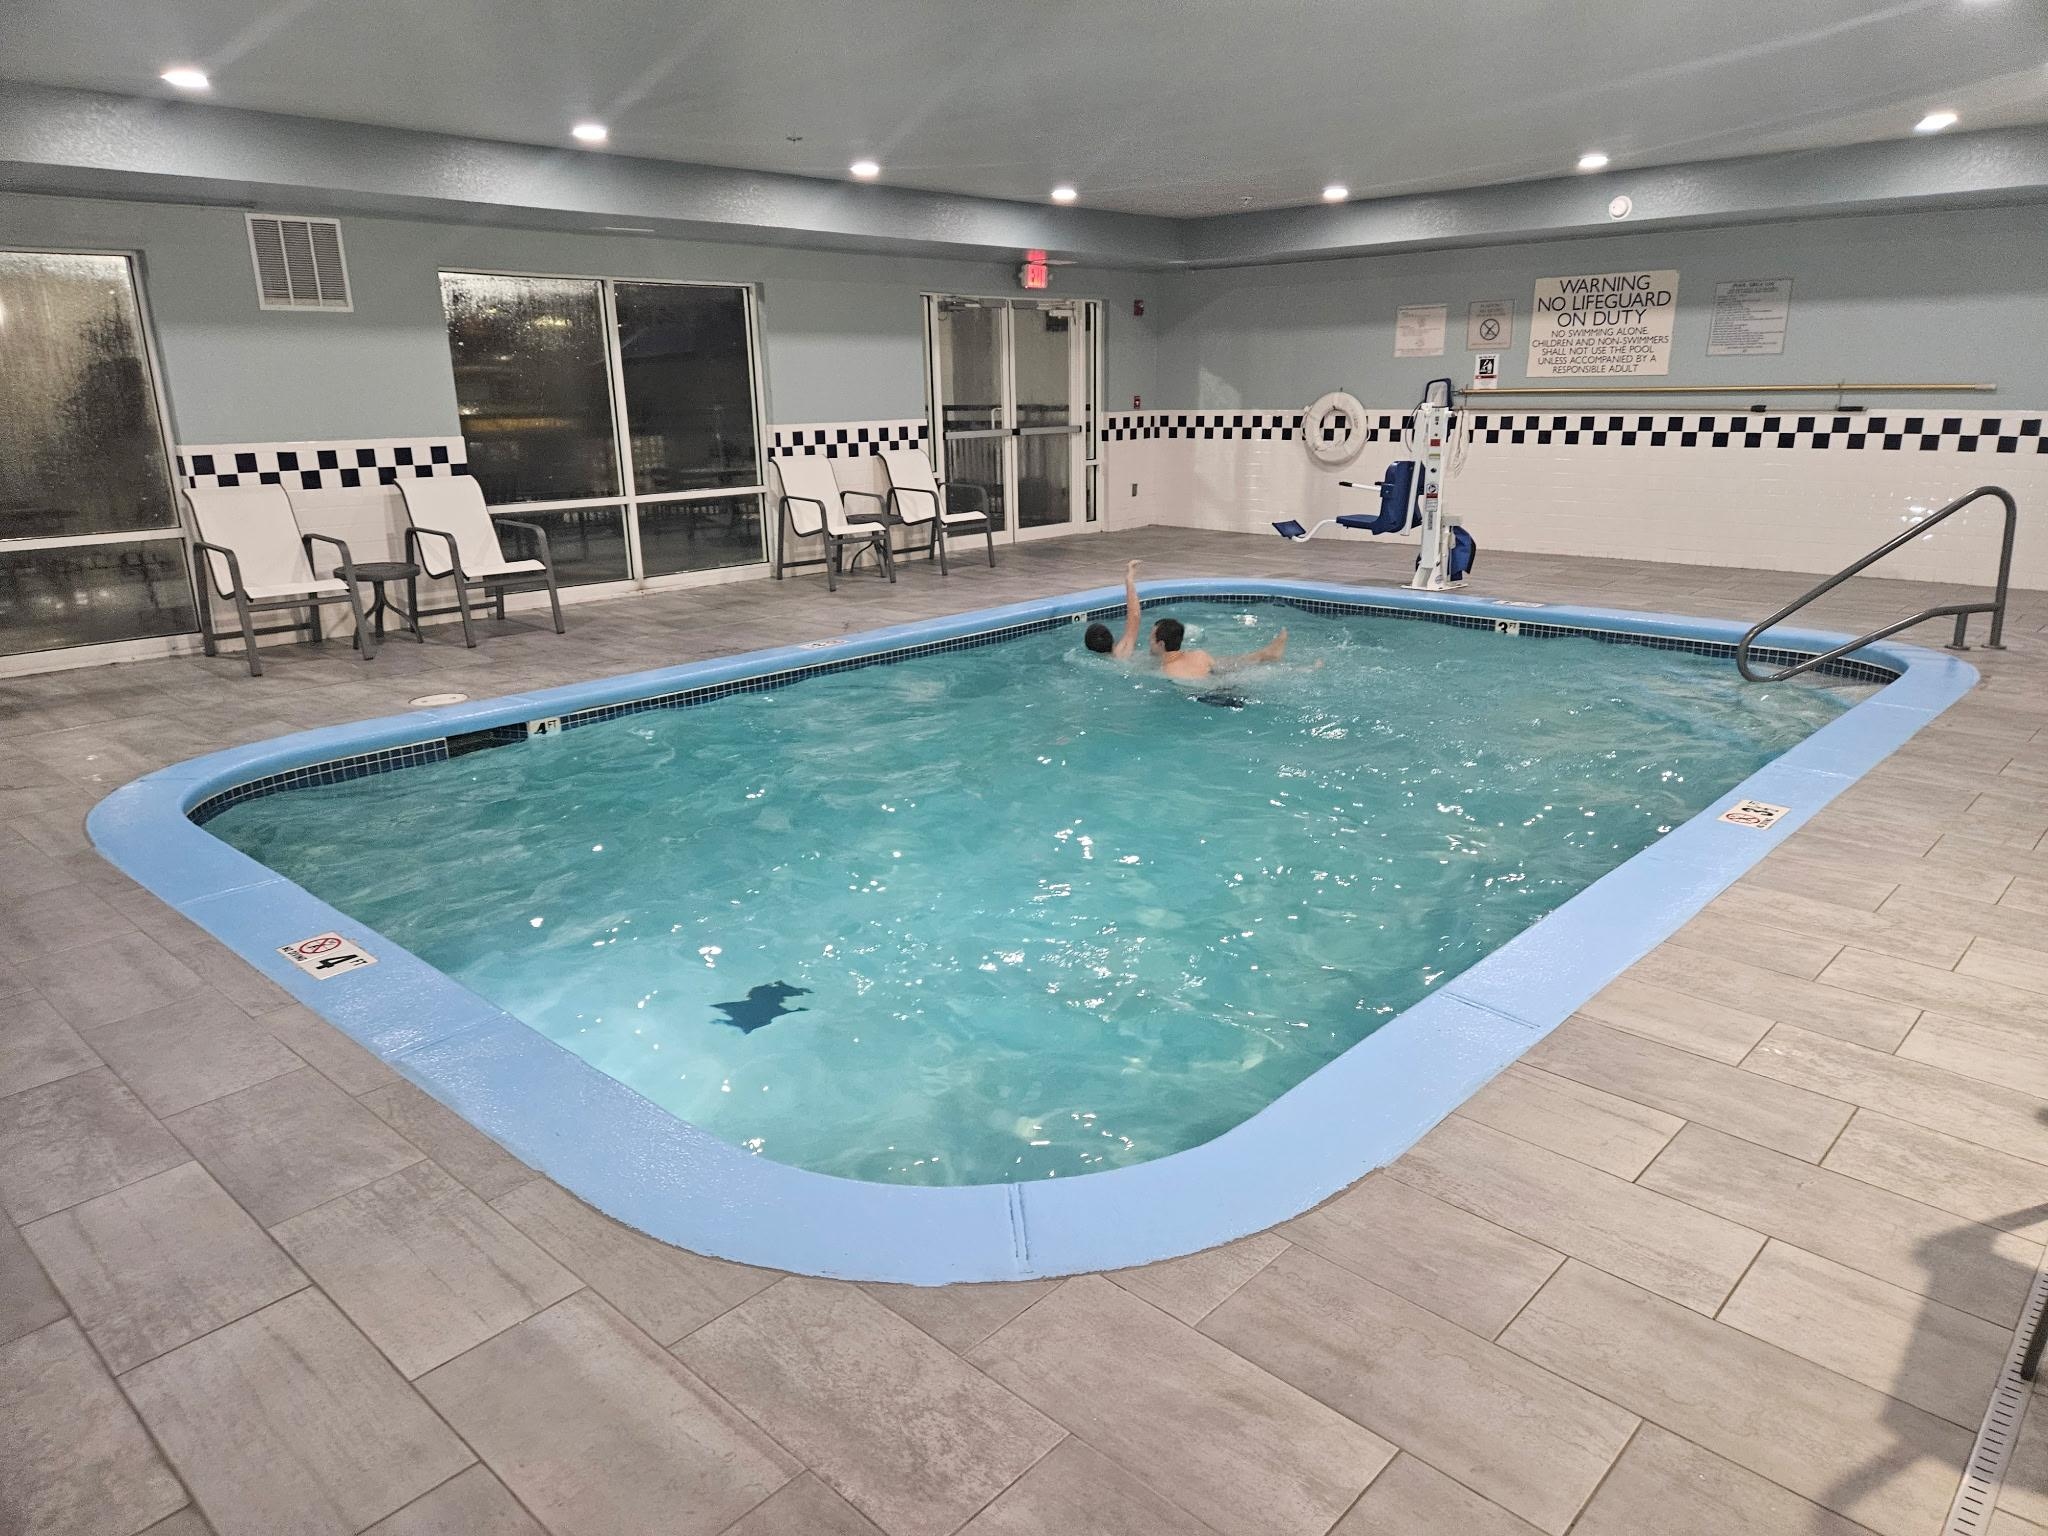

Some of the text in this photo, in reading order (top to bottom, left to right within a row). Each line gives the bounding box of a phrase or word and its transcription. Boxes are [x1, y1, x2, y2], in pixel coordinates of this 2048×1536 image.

[1559, 274, 1651, 294] WARNING
[1537, 290, 1671, 312] NO LIFEGUARD
[1557, 309, 1647, 327] ON DUTY
[1551, 326, 1648, 338] NO SWIMMING ALONE
[1532, 335, 1669, 347] CHILDREN AND NON-SWIMMERS
[1542, 345, 1654, 356] SHALL NOT USE THE POOL
[1538, 357, 1567, 365] UNLESS
[1569, 355, 1633, 364] ACCOMPANIED
[1636, 355, 1648, 363] BY
[1552, 364, 1639, 374] RESPONSIBLE ADULT
[534, 720, 557, 734] 4 FT
[316, 954, 358, 969] 4
